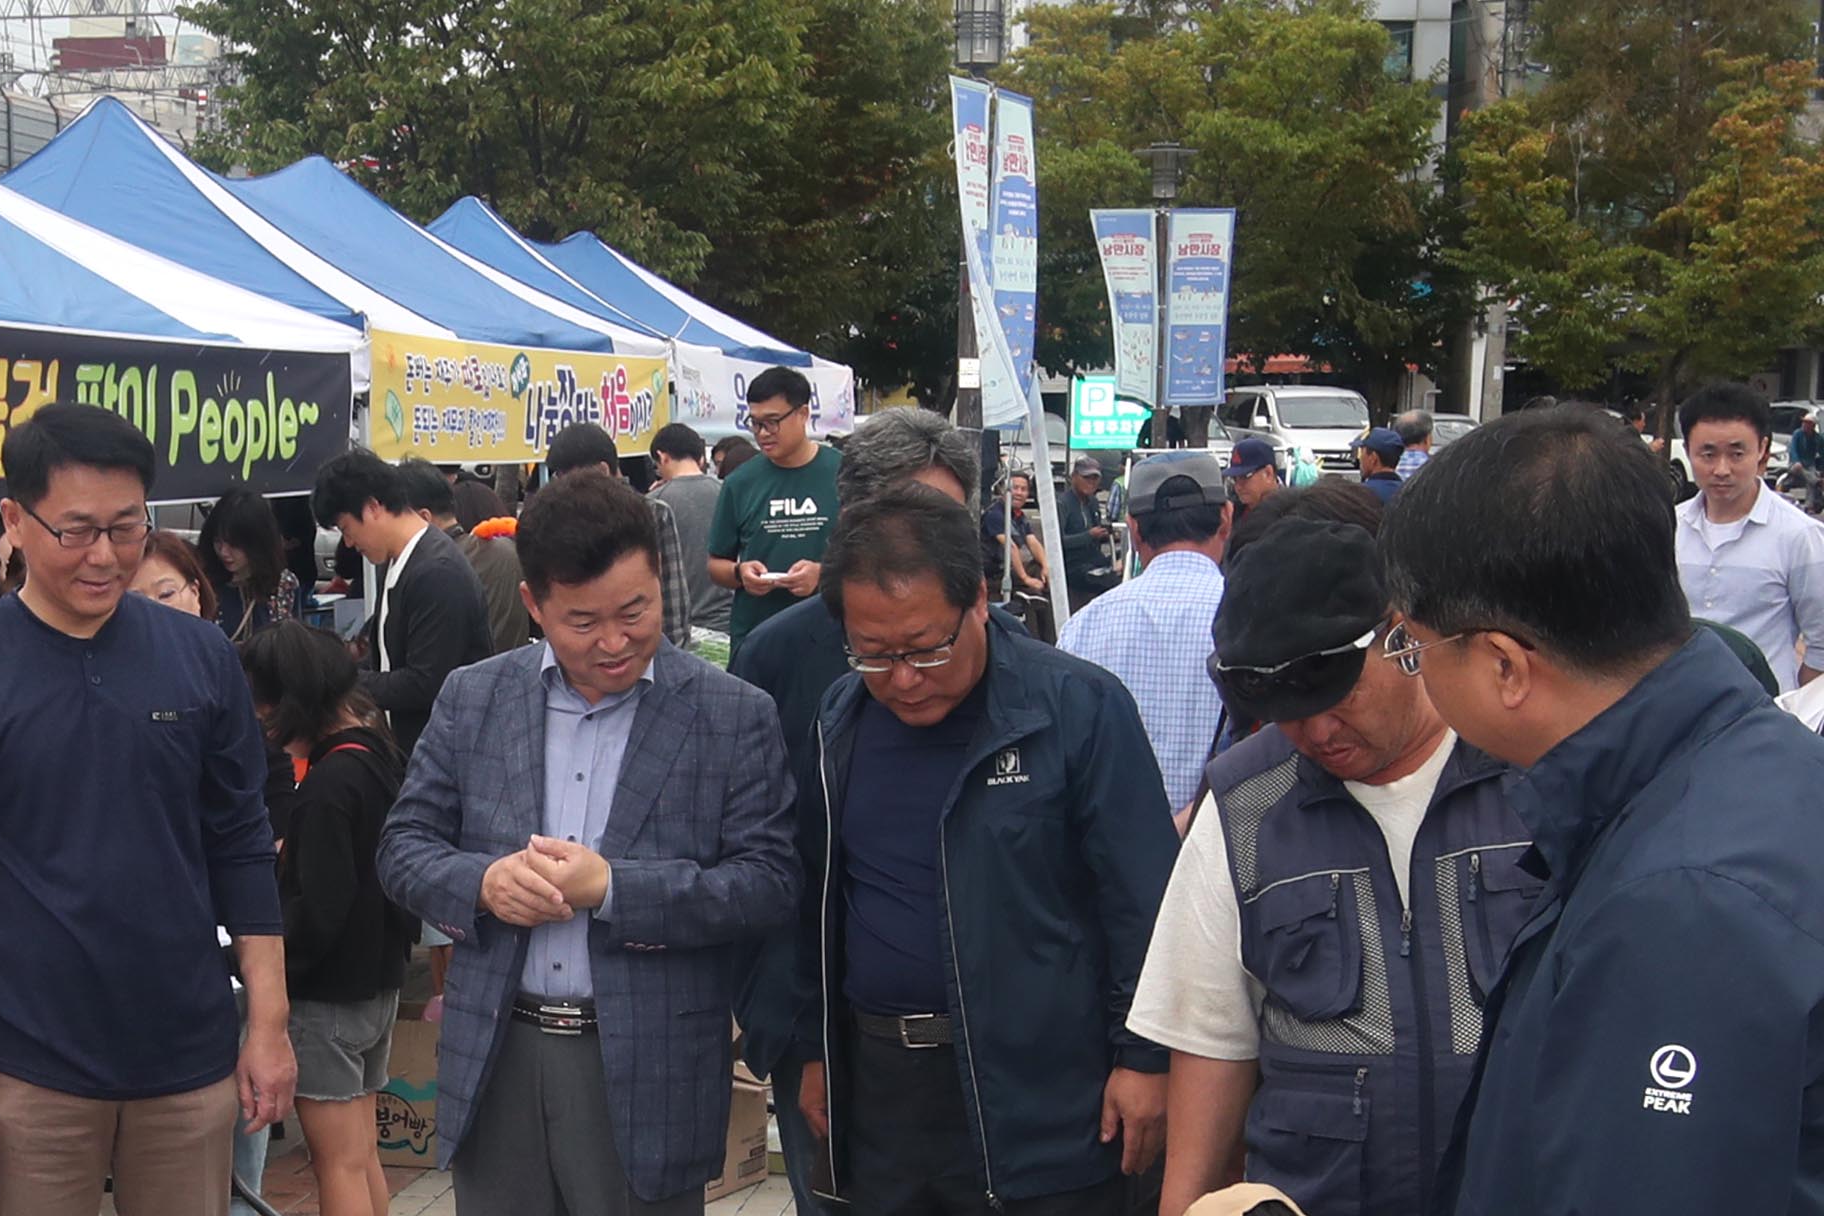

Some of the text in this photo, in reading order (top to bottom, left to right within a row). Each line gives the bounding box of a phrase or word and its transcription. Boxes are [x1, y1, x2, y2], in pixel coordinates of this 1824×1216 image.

[1088, 386, 1107, 412] P
[769, 497, 818, 517] FILA
[1643, 1095, 1692, 1115] PEAK
[375, 1106, 428, 1139] 붕어빵
